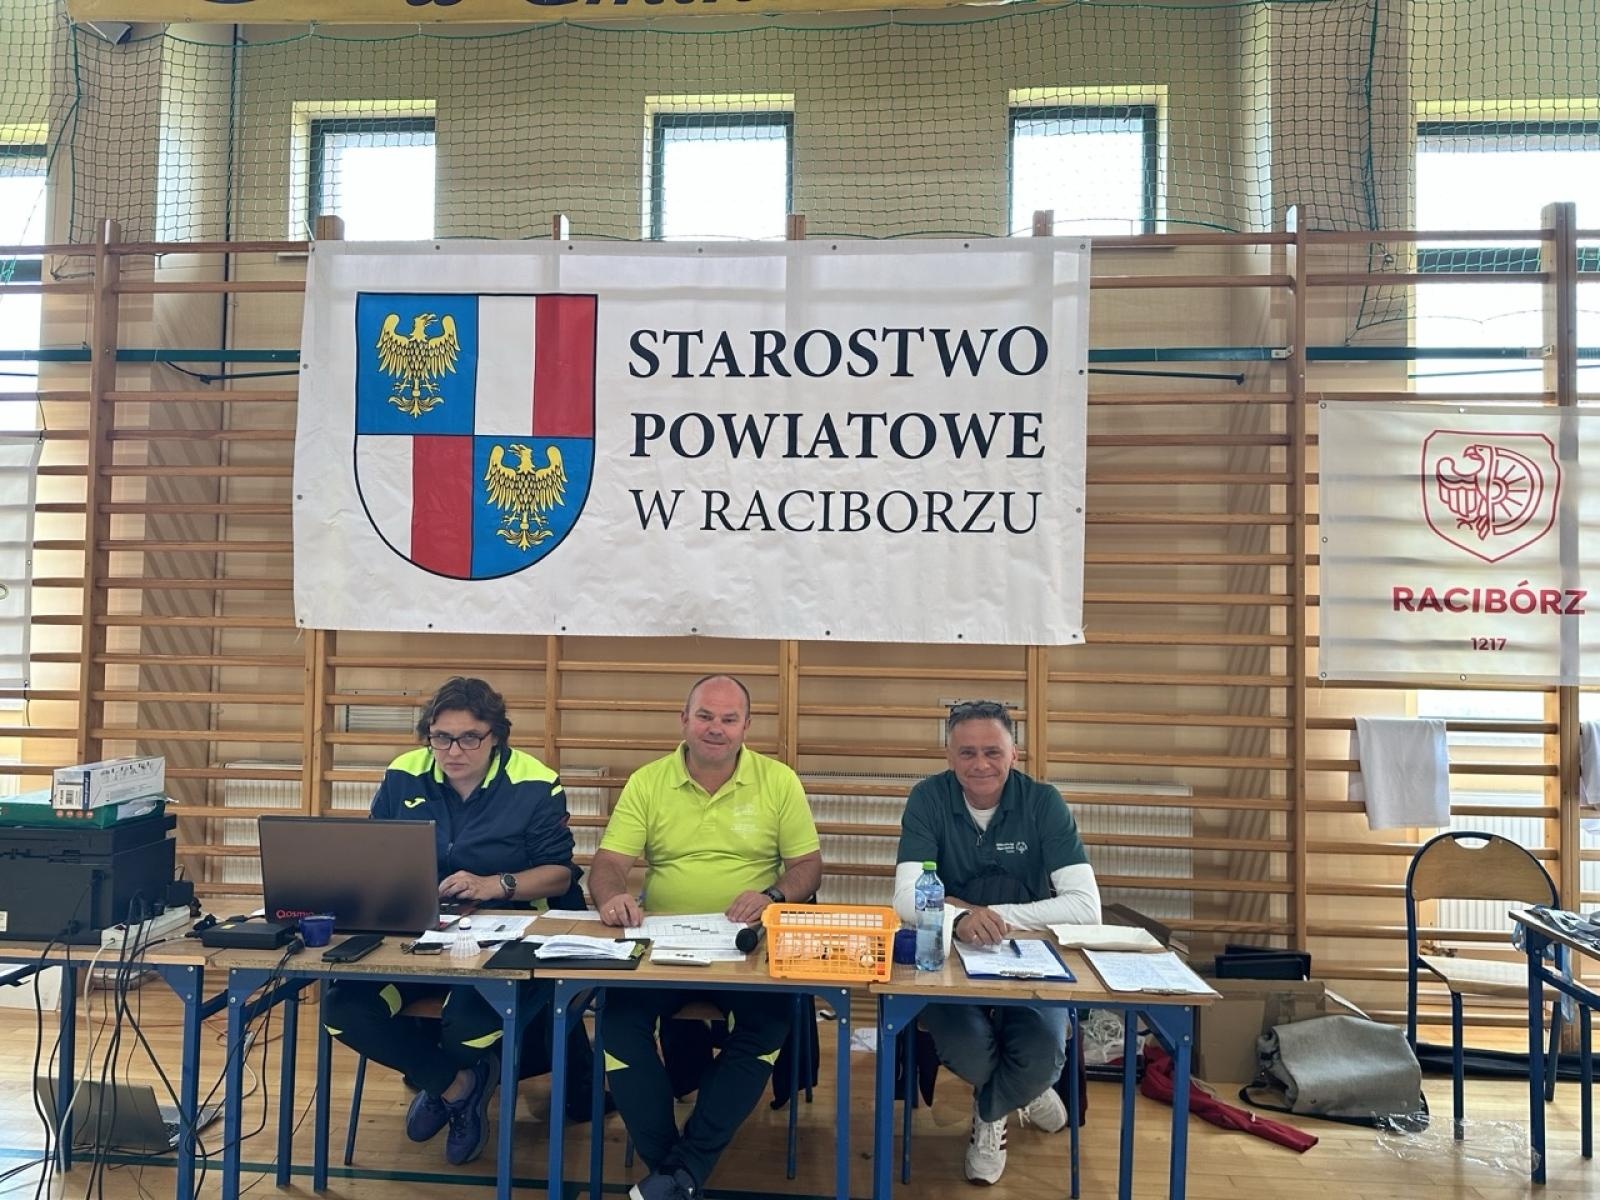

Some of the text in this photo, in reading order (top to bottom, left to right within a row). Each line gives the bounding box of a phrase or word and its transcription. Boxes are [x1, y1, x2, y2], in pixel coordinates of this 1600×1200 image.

[629, 326, 1049, 379] STAROSTWO
[630, 411, 1046, 460] POWIATOWE
[629, 489, 1043, 535] W RACIBORZU
[1392, 580, 1587, 615] RACIBÓRZ
[1471, 637, 1507, 651] 1217
